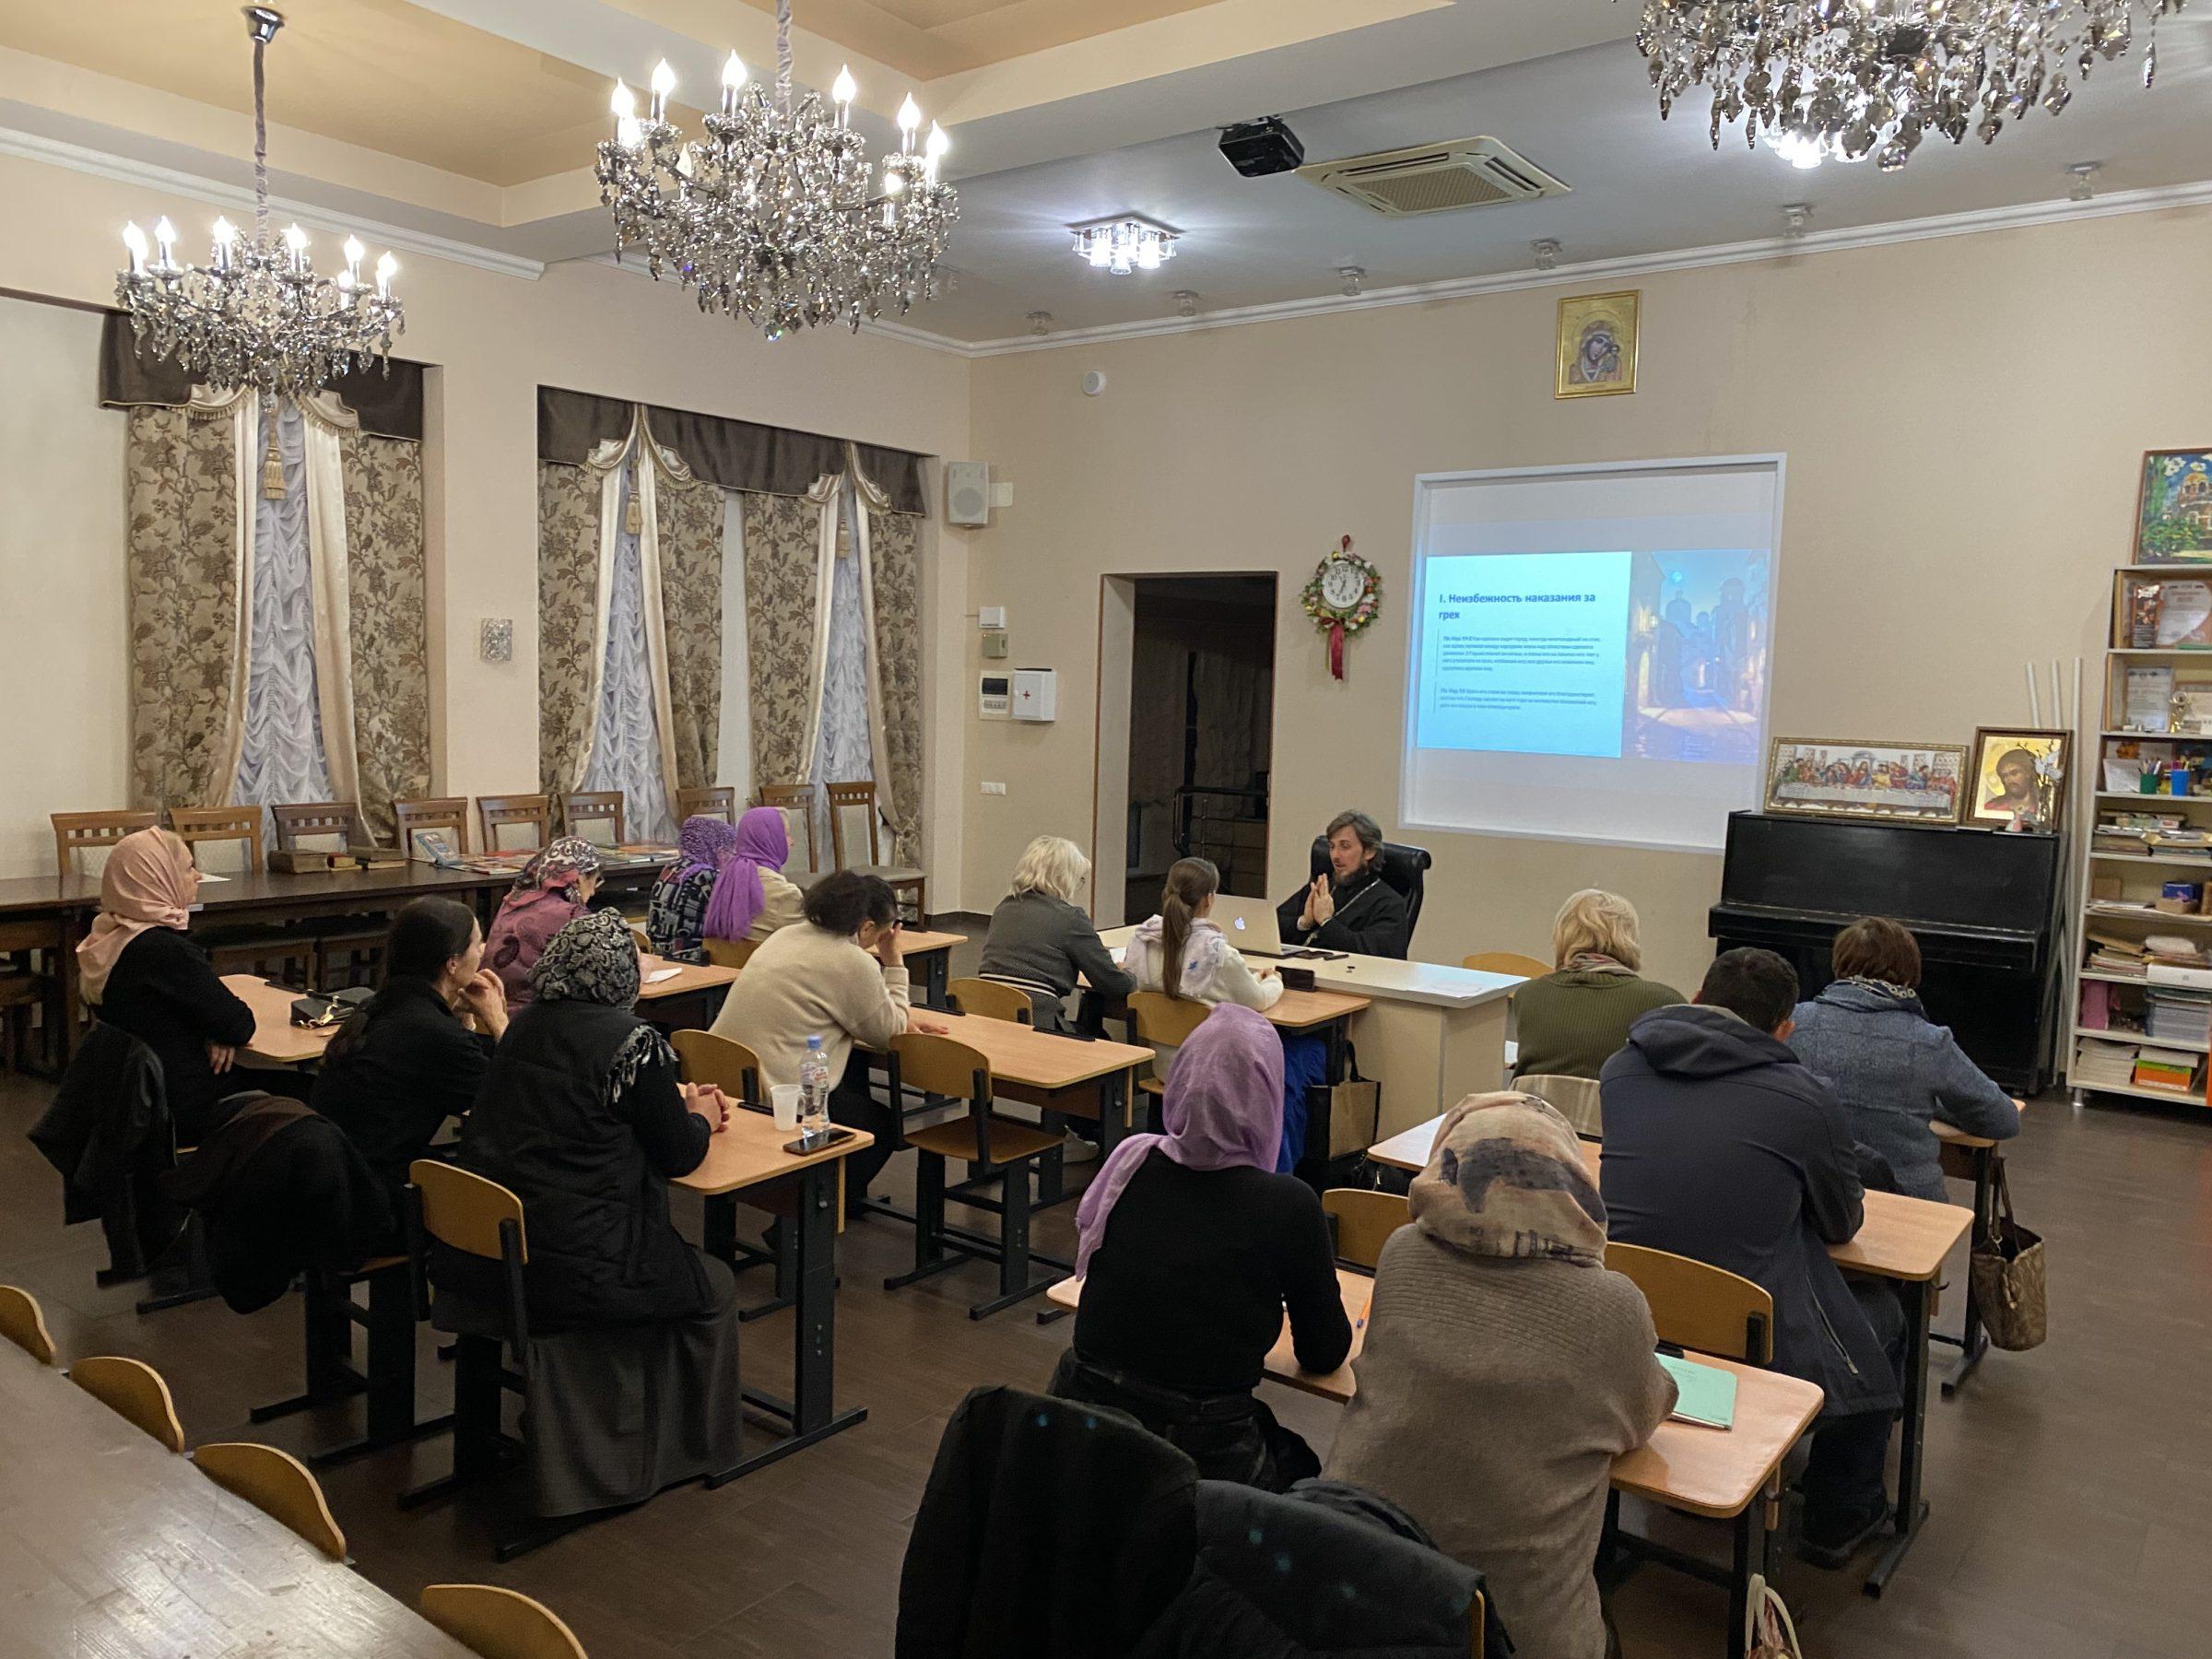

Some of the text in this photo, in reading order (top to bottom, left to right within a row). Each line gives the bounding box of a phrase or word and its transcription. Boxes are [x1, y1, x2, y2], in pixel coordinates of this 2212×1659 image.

[1449, 593, 1522, 604] Неизбежность
[1525, 594, 1581, 603] наказания
[1584, 594, 1595, 603] за
[1439, 611, 1460, 621] грех
